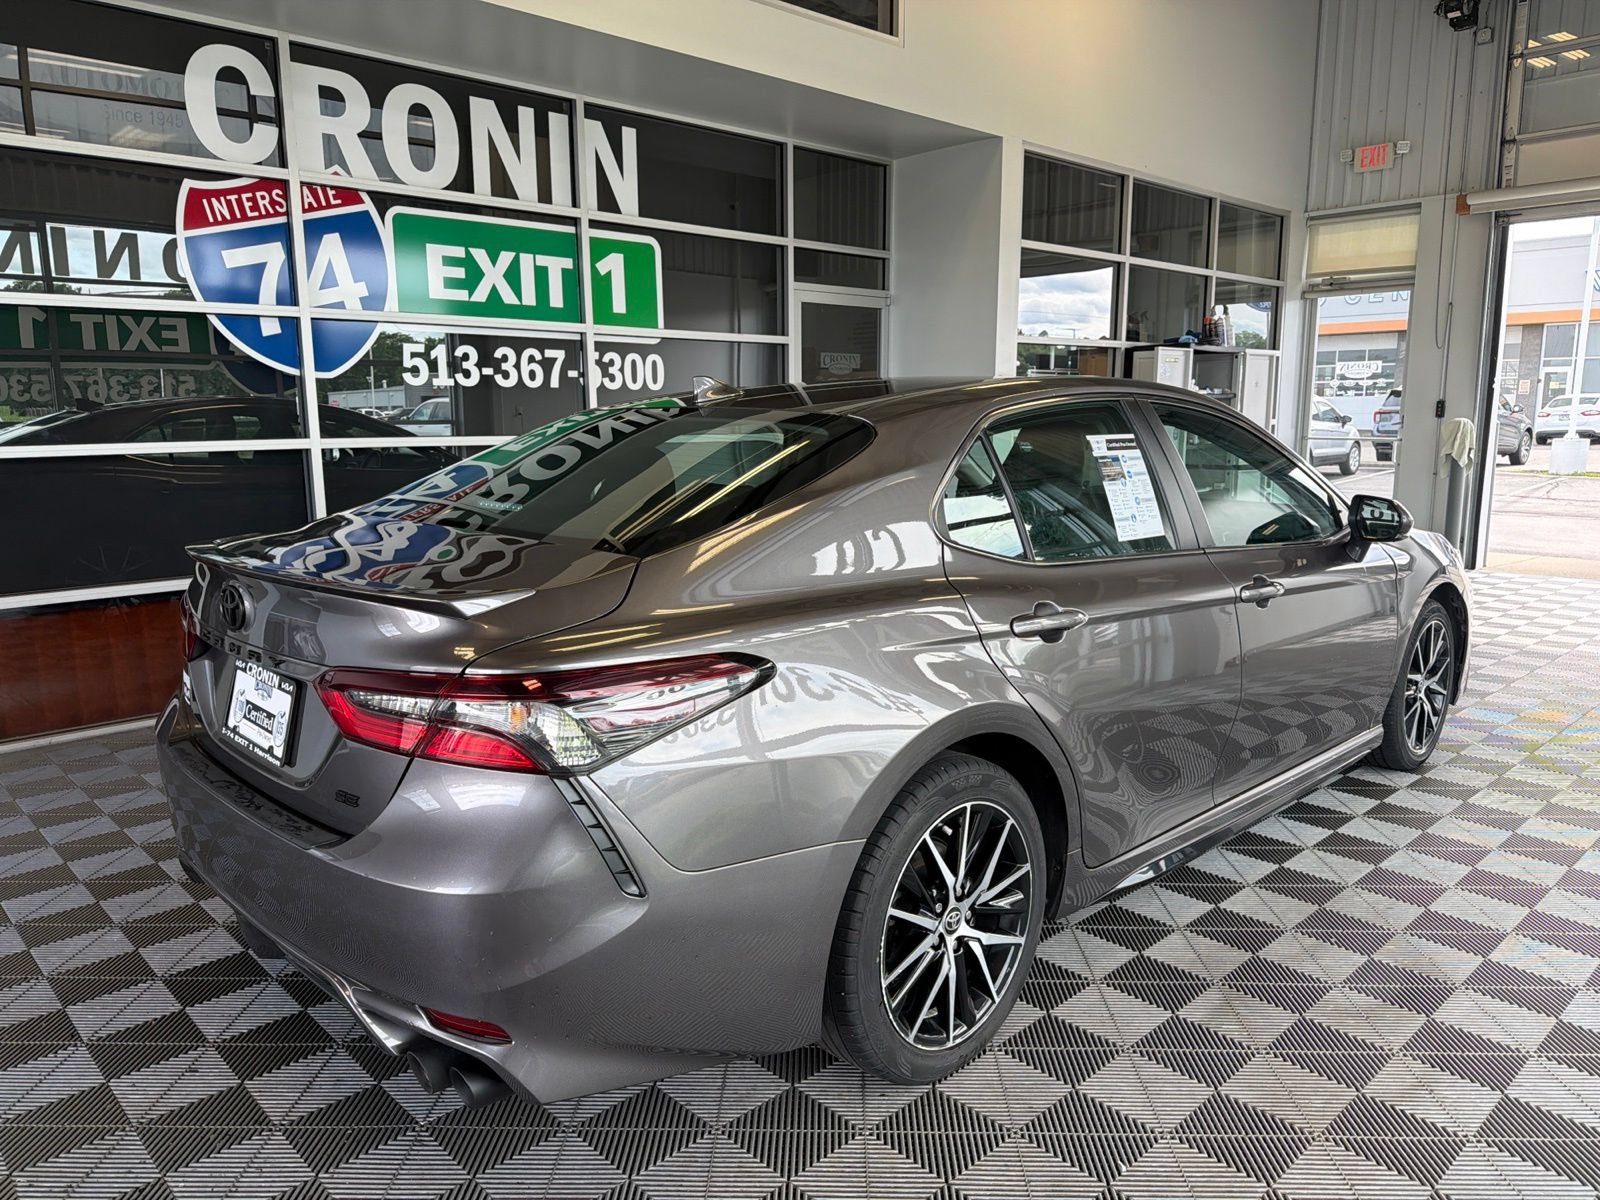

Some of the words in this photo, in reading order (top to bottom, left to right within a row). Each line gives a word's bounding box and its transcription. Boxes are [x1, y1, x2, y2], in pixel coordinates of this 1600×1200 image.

[184, 43, 640, 219] CRONIN
[1360, 145, 1387, 168] EXIT
[221, 232, 370, 337] 74
[427, 243, 574, 308] EXIT
[595, 252, 627, 314] 1
[402, 342, 664, 391] 513-367-5300
[246, 662, 280, 689] CRONIN
[245, 705, 274, 731] Certified
